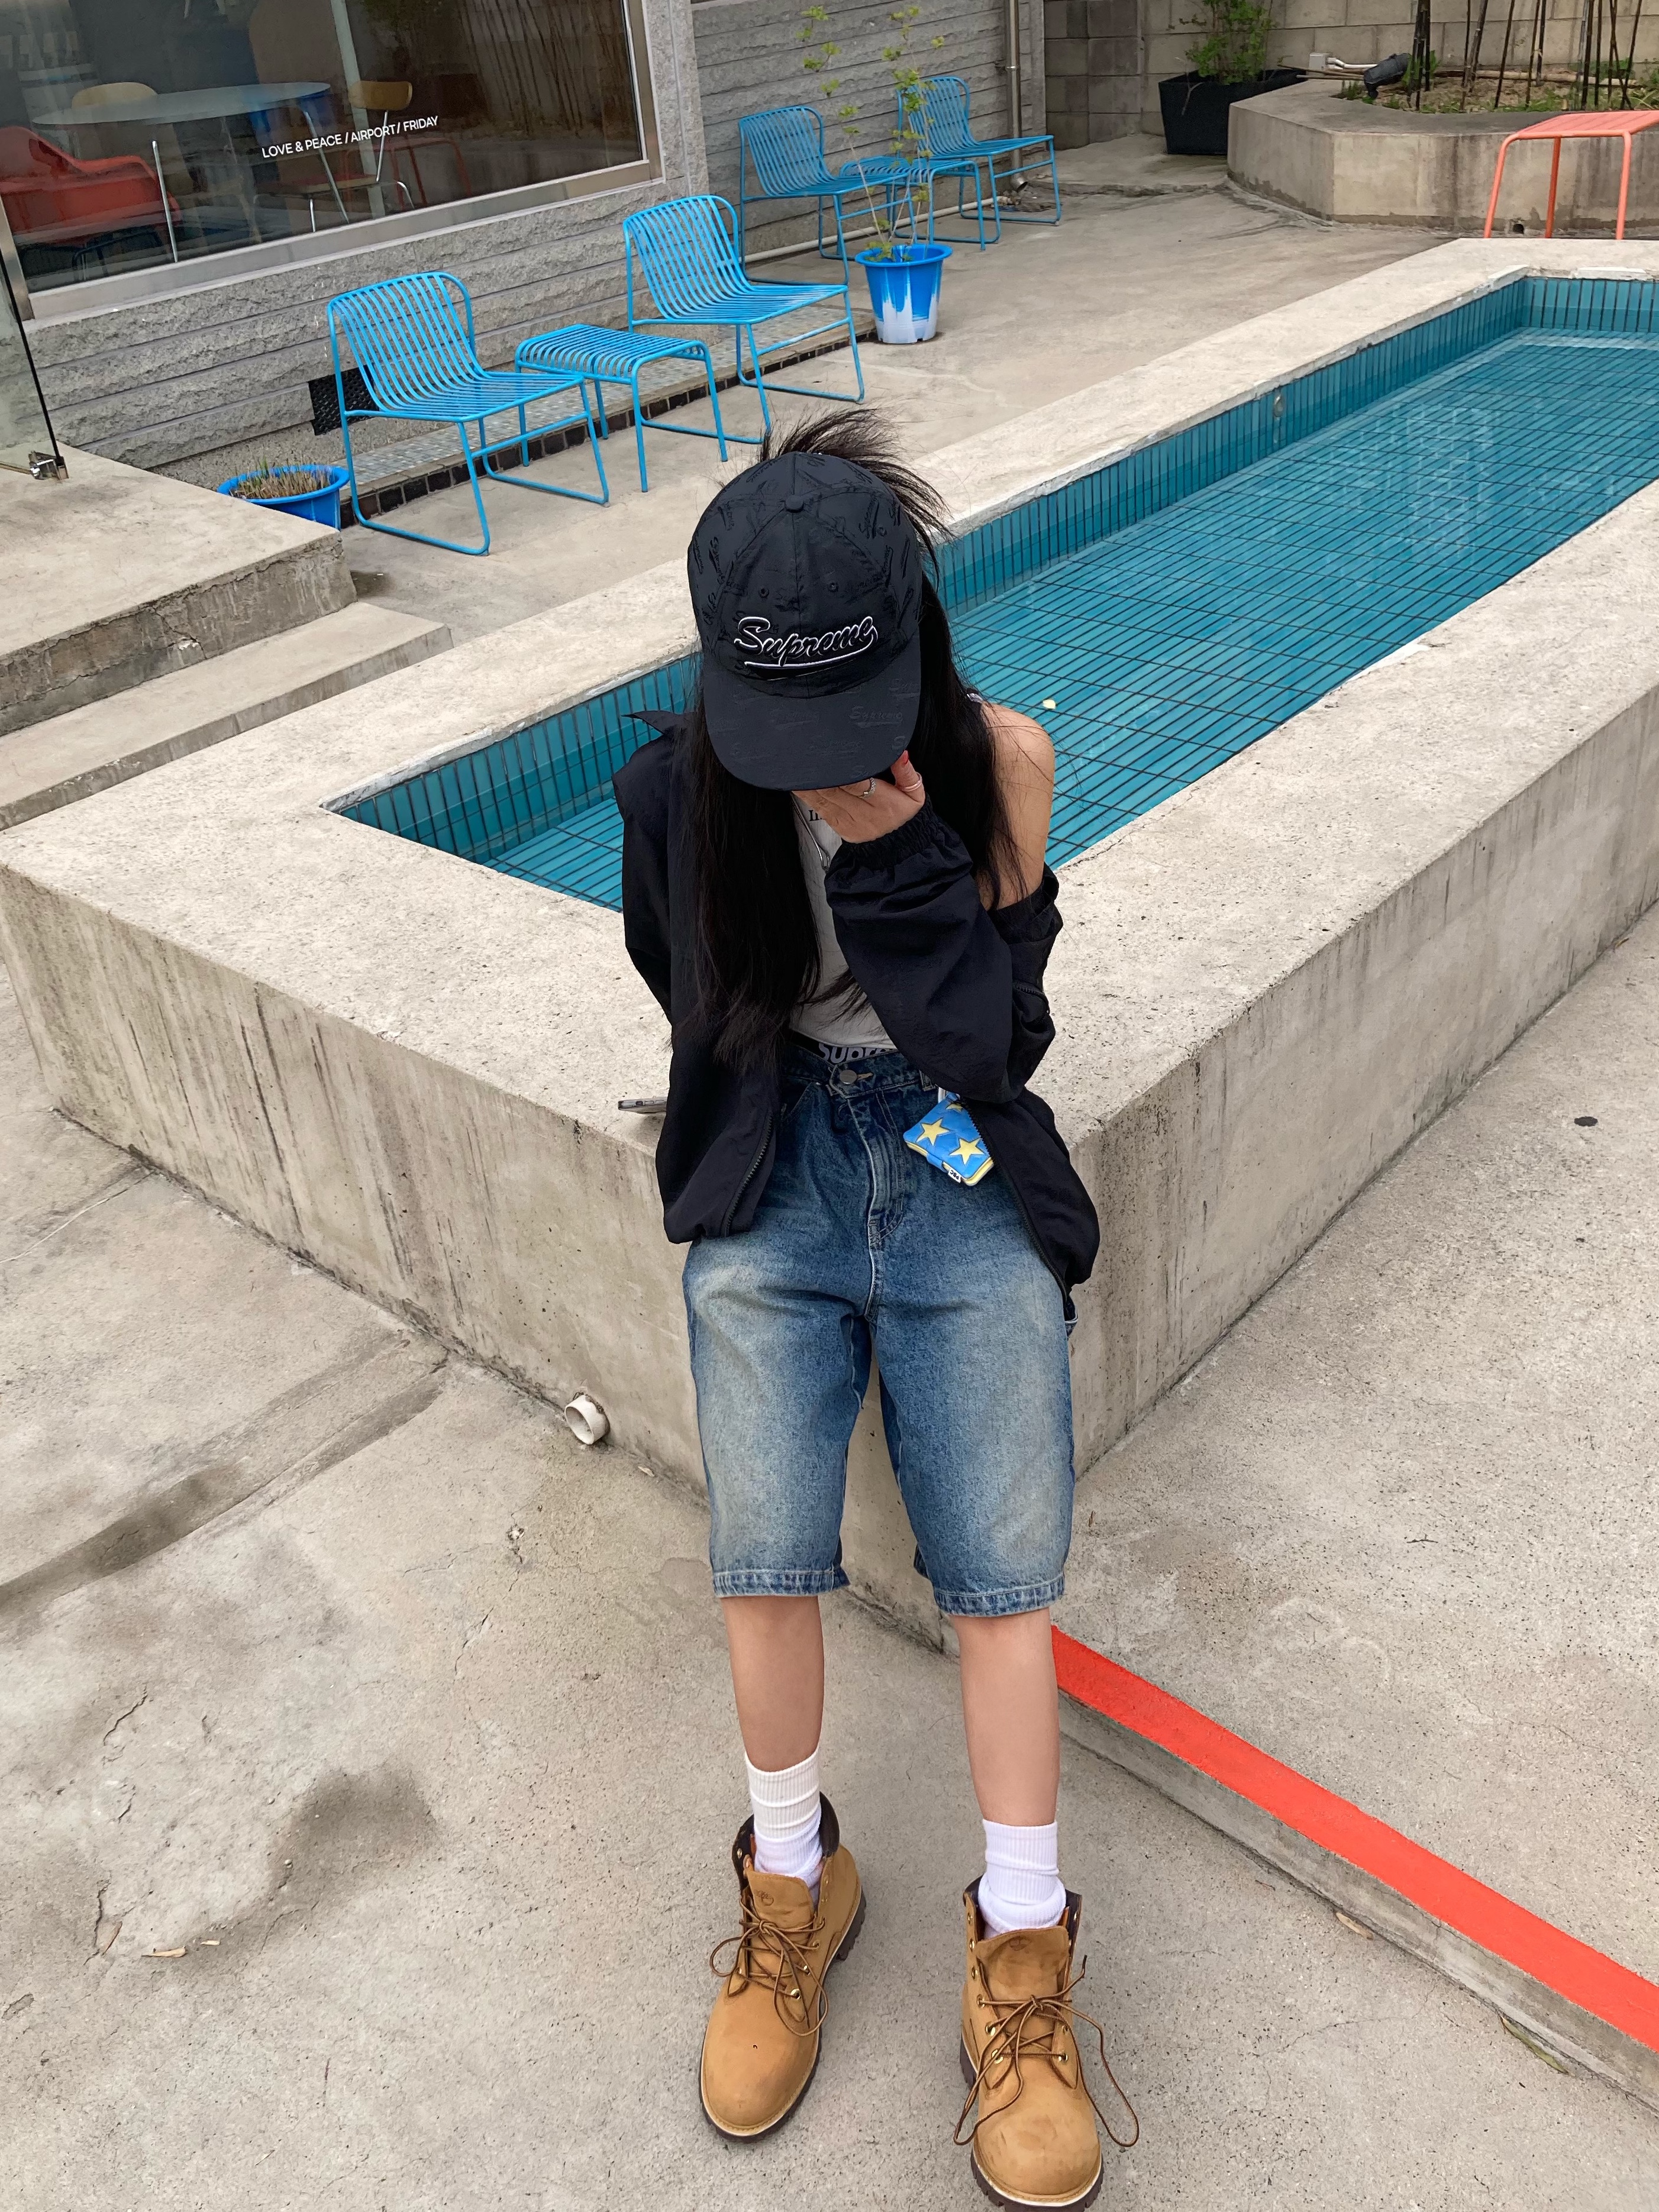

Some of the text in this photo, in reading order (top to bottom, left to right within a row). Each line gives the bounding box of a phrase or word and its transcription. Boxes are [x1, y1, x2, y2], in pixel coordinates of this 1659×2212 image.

[262, 115, 438, 158] LOVE & PEACE / AIRPORT / FRIDAY
[734, 615, 879, 674] Supreme
